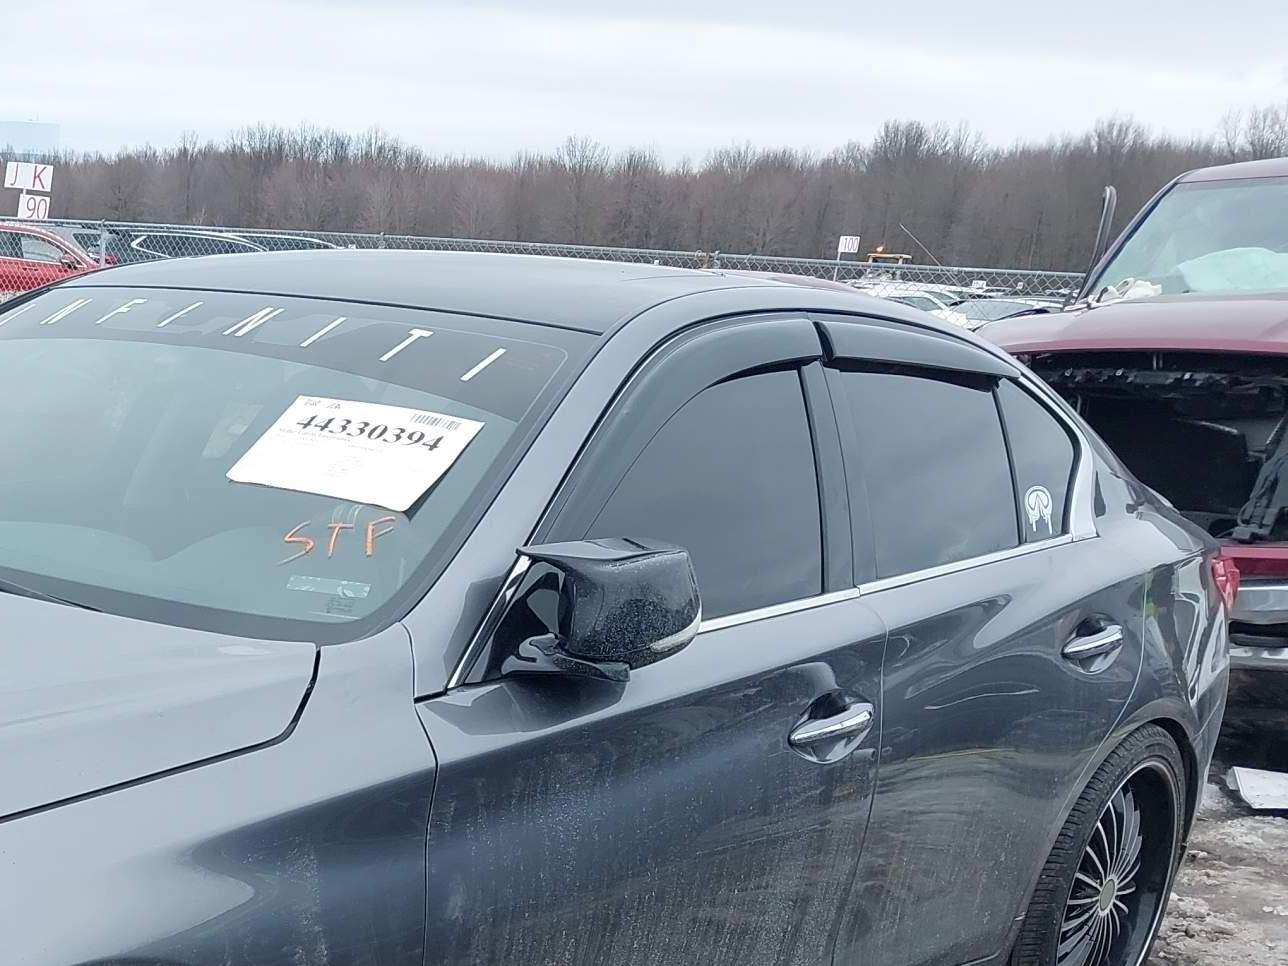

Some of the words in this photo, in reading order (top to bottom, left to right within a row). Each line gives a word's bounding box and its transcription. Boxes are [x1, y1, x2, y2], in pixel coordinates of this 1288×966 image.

[32, 165, 48, 190] K
[26, 196, 48, 220] 90
[844, 237, 859, 251] 100
[296, 414, 444, 451] 44330394
